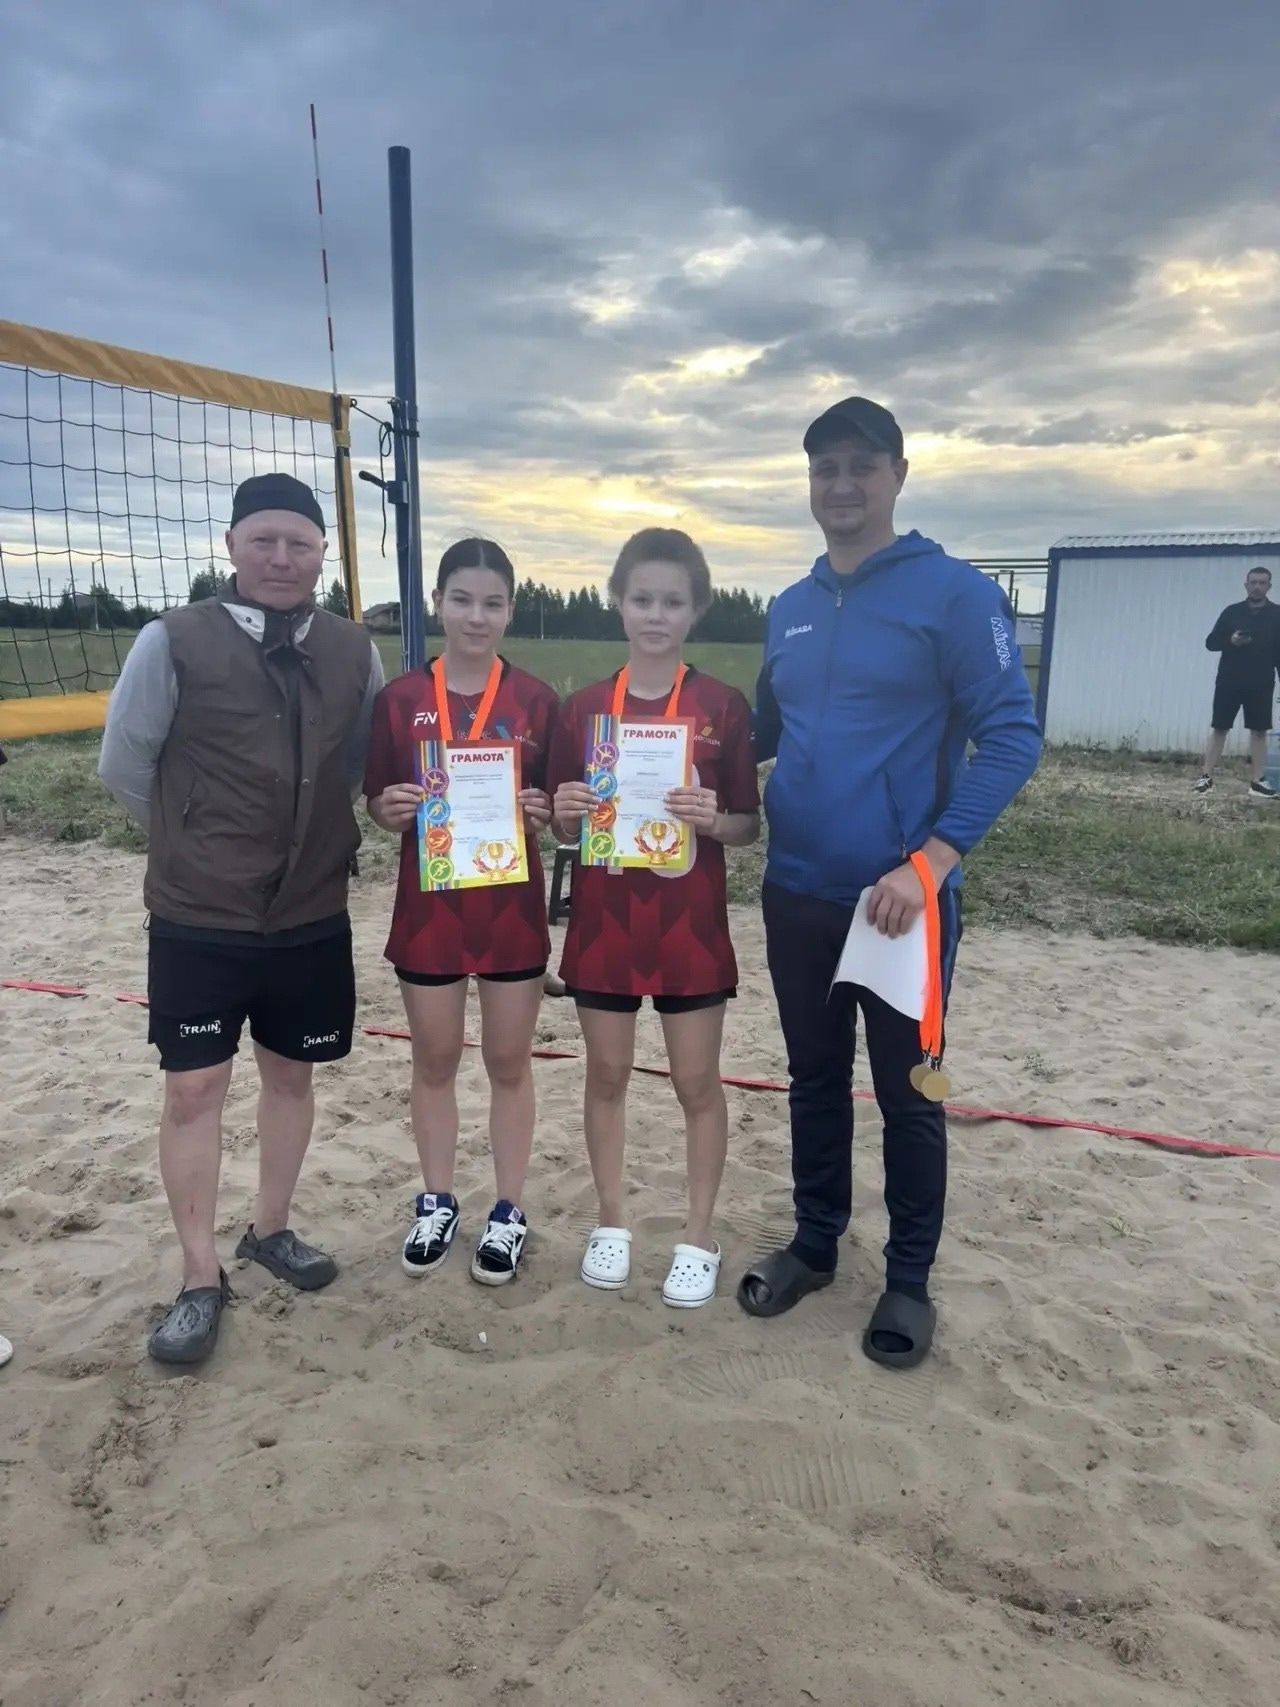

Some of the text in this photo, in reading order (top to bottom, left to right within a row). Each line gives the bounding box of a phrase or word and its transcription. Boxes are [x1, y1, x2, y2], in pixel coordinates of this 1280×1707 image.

[414, 711, 438, 726] FN
[623, 729, 678, 740] ГРАМОТА
[451, 752, 505, 763] ГРАМОТА
